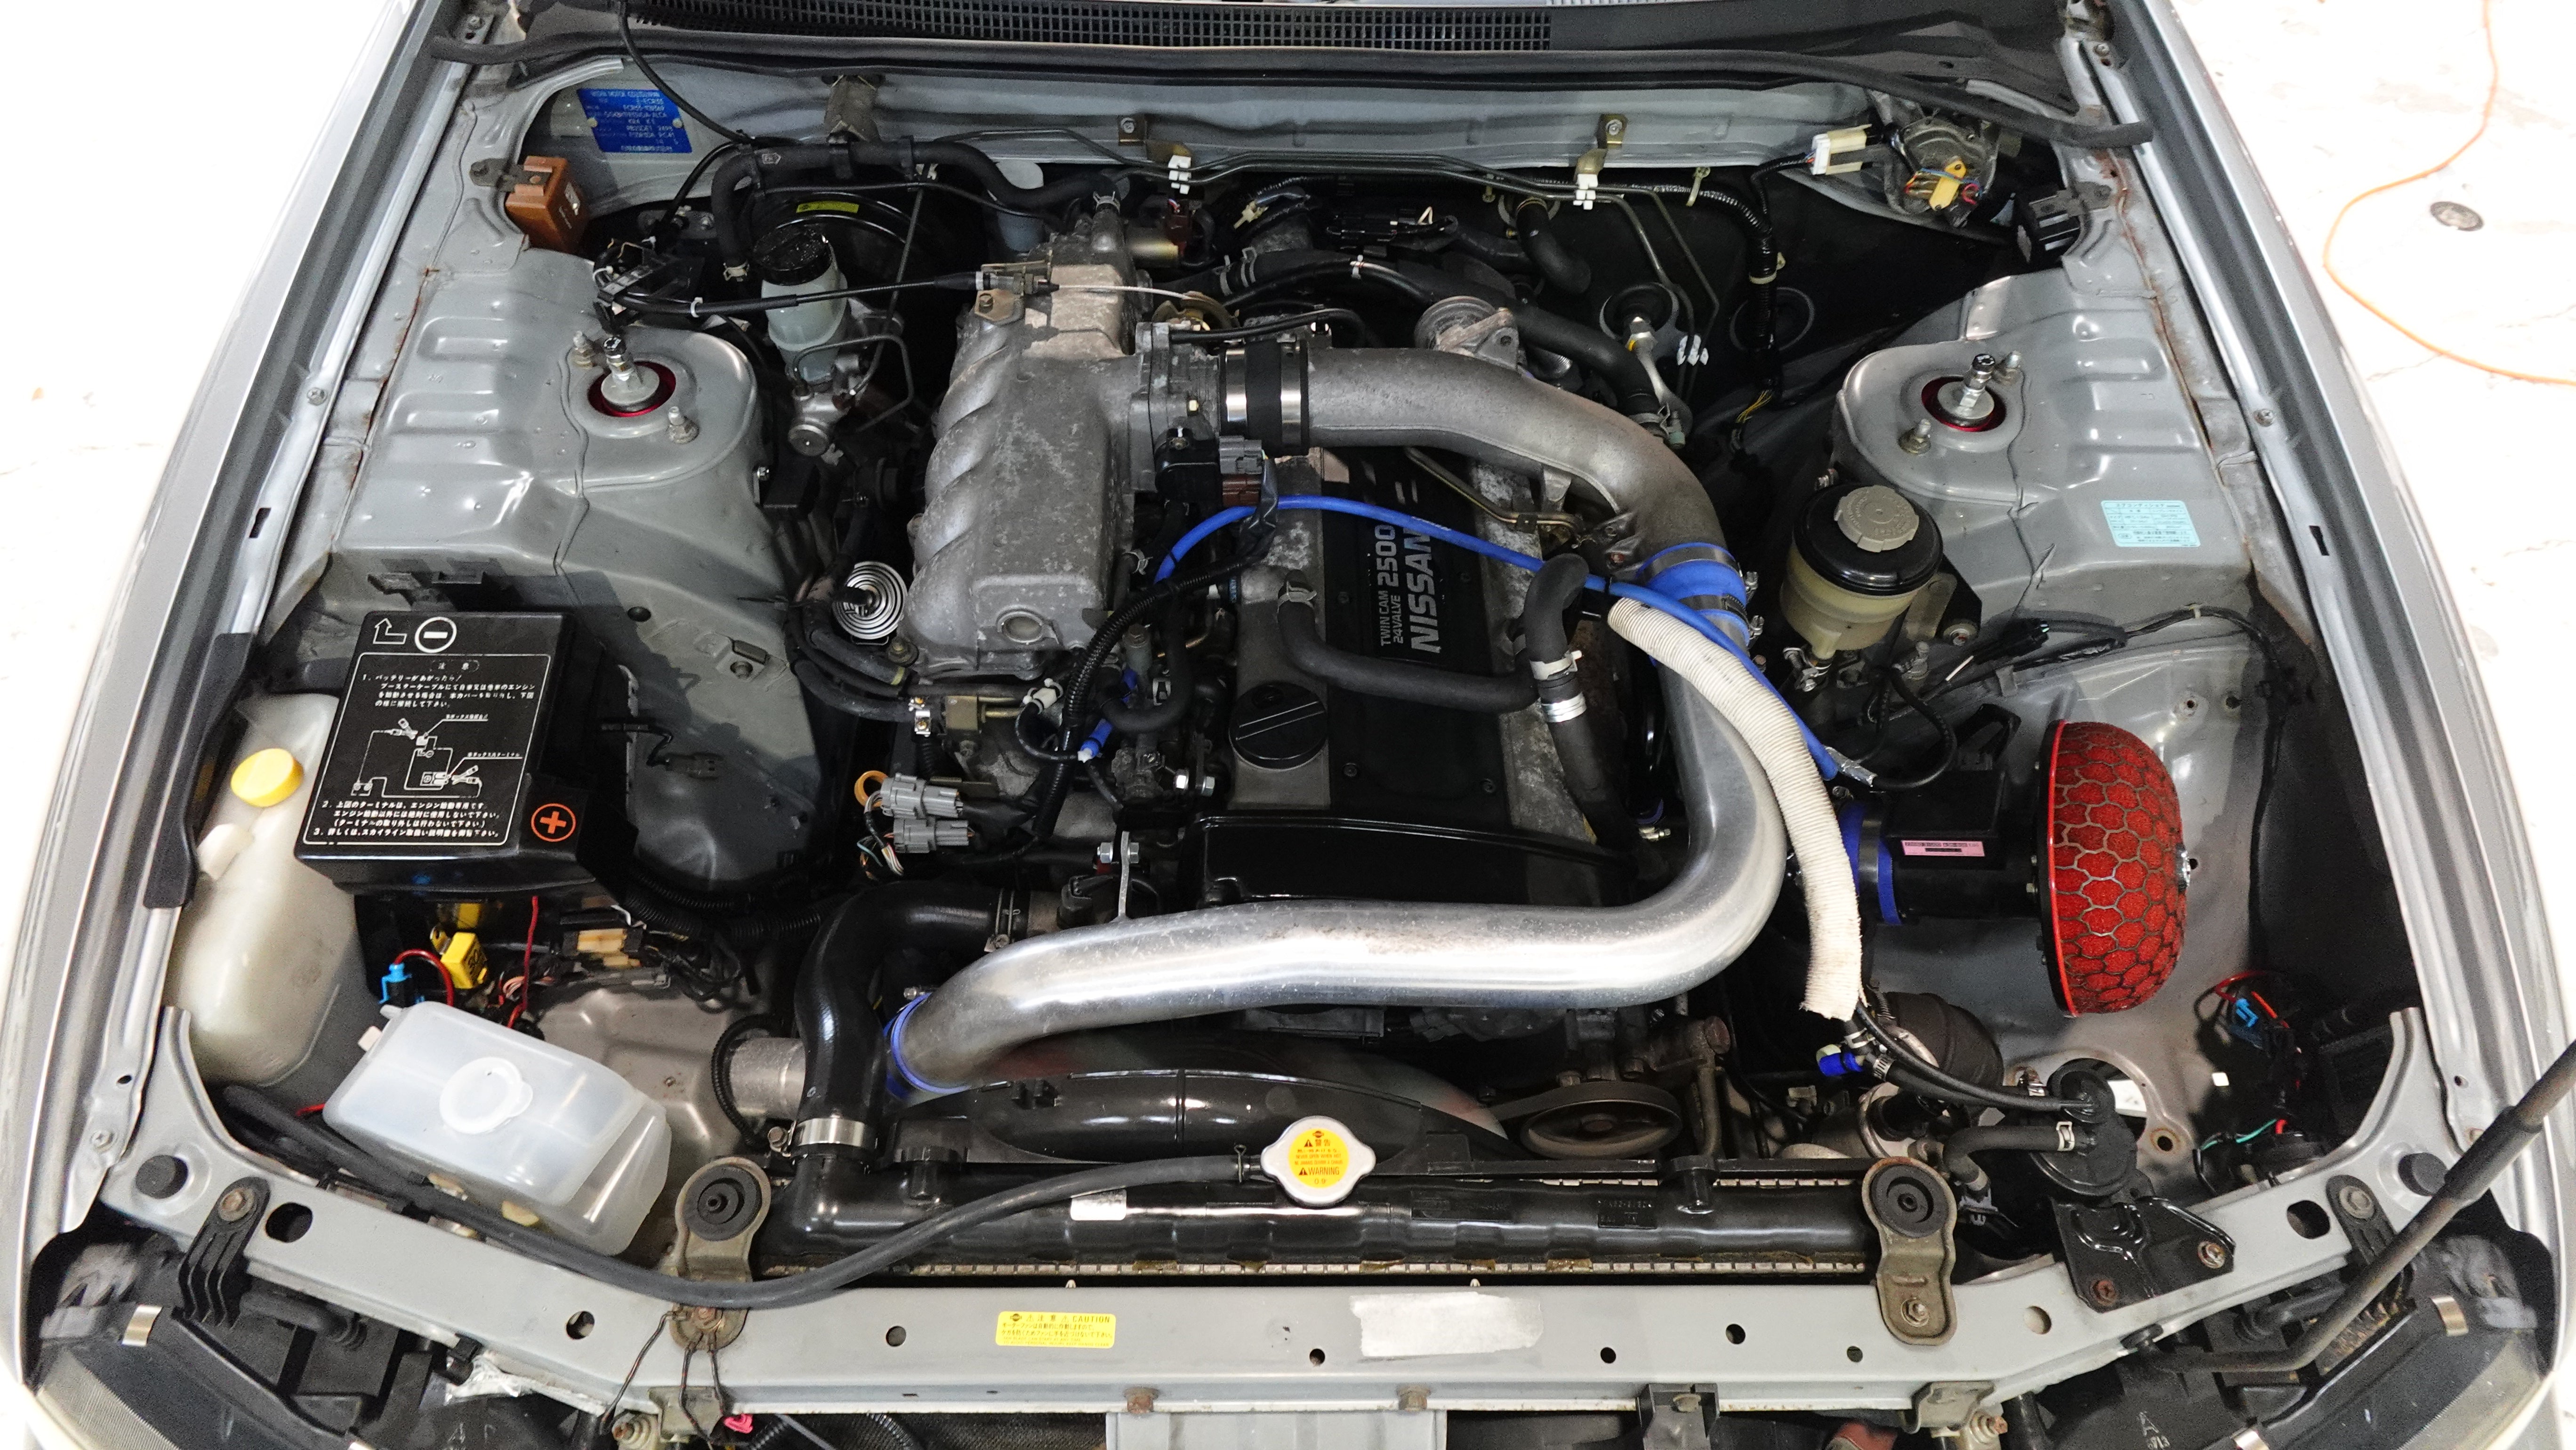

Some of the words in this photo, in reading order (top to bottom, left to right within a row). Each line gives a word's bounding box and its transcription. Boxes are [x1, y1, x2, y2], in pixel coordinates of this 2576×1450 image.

[1374, 524, 1399, 587] 2500
[1378, 590, 1390, 615] CAM
[1380, 618, 1391, 646] TWIN
[1391, 595, 1404, 644] 24VALVE
[1308, 1167, 1339, 1175] WARNING
